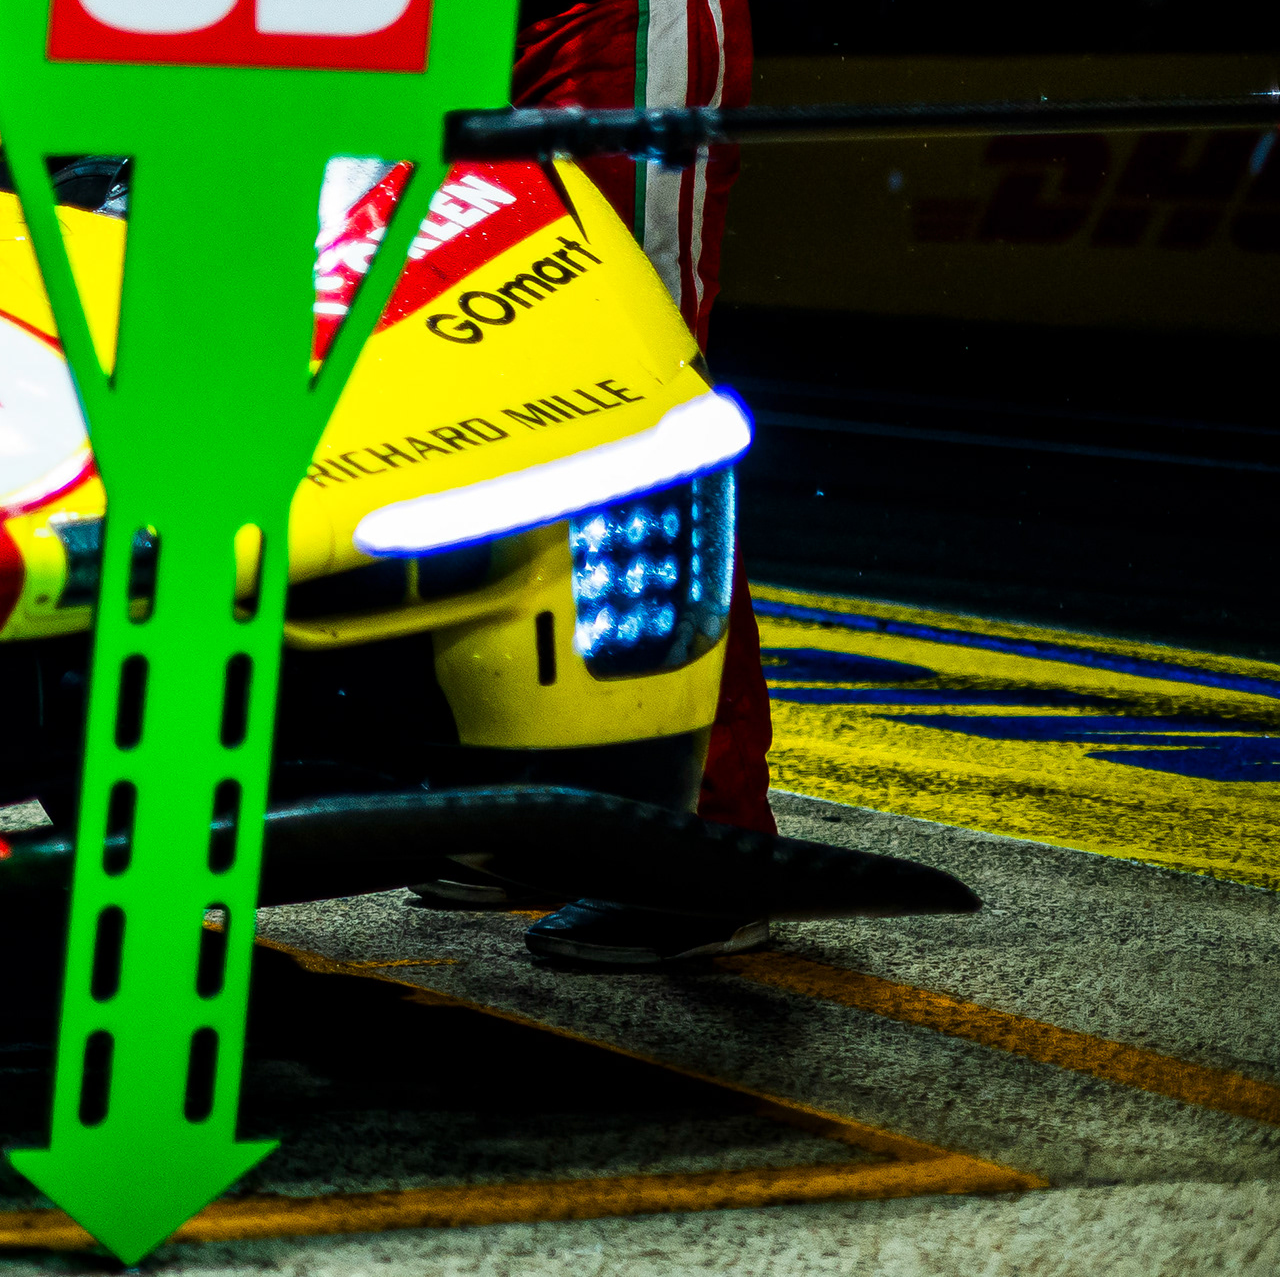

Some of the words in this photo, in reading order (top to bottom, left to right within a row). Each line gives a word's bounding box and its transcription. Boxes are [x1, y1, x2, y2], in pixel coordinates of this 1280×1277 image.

[425, 235, 604, 345] GOmart
[306, 417, 512, 489] RICHARD
[500, 378, 647, 431] MILLE
